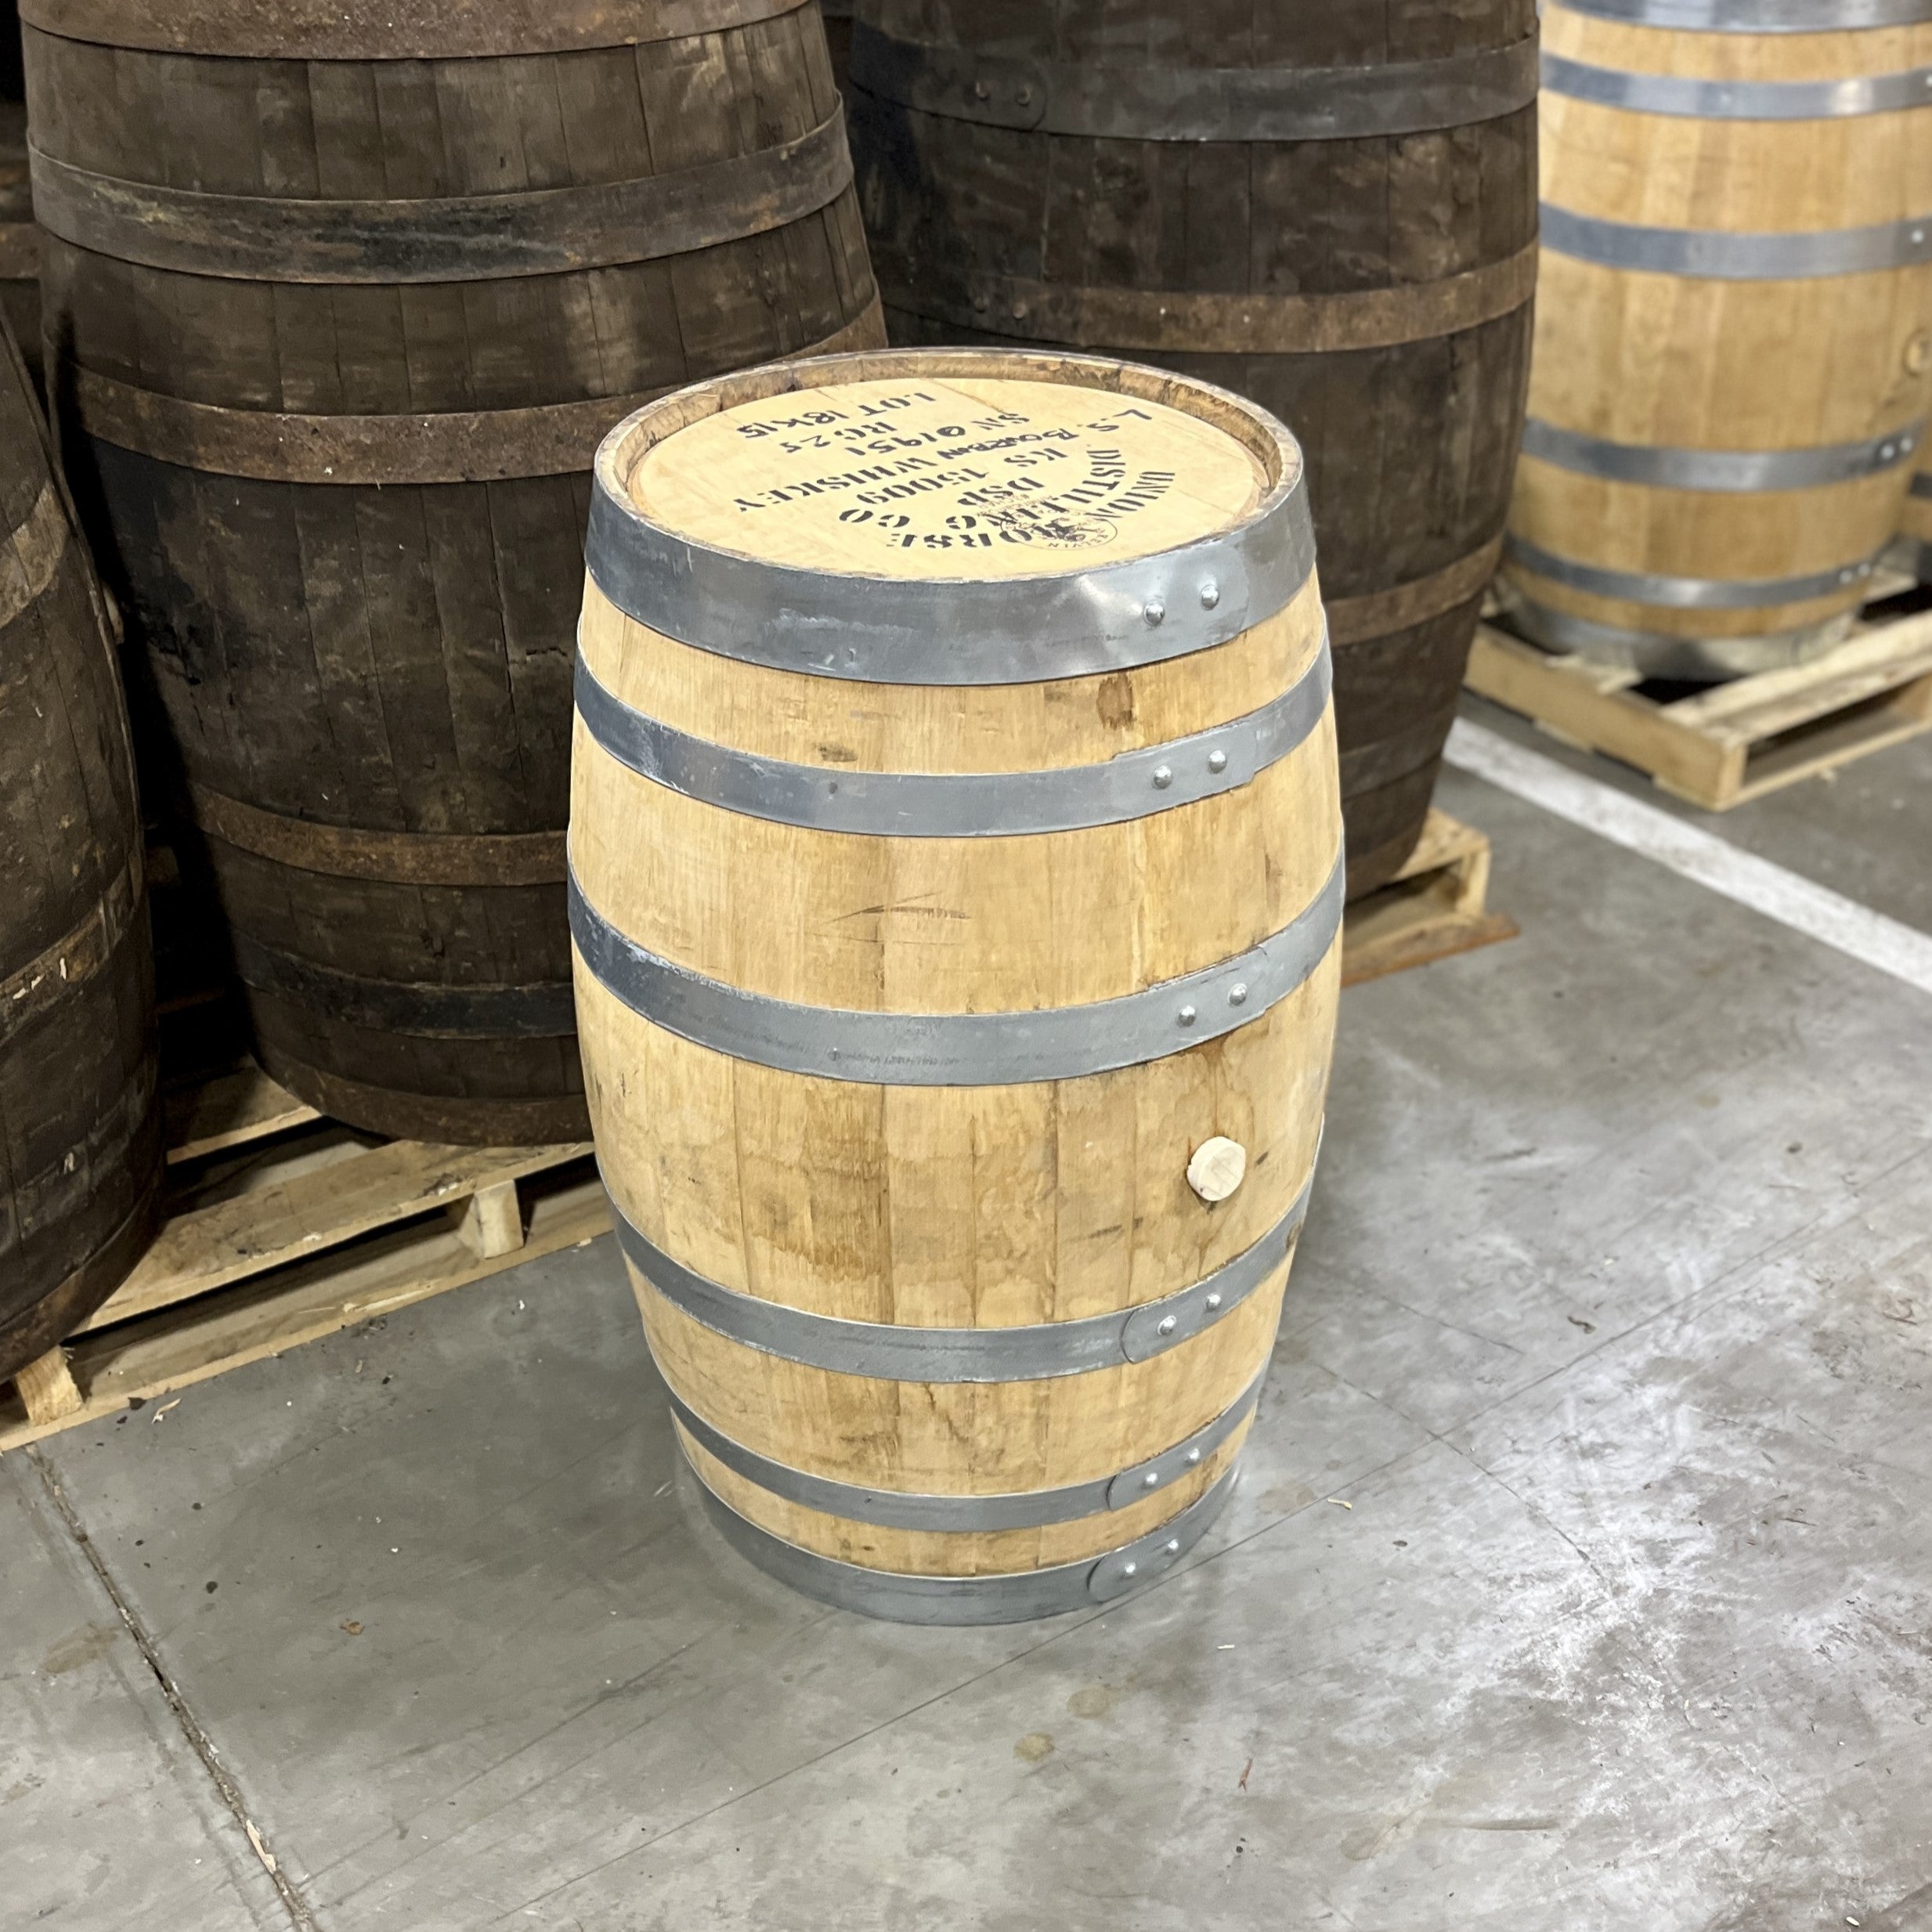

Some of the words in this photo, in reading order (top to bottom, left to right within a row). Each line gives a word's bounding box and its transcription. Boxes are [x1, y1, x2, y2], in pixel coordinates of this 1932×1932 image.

[858, 392, 936, 416] LOT
[834, 422, 897, 441] RG
[971, 413, 1030, 431] SN
[1004, 448, 1068, 468] KS
[733, 457, 938, 512] WHISKEY
[856, 468, 989, 504] 15009
[957, 477, 1045, 506] DSP
[1084, 471, 1175, 518] UNION
[839, 509, 910, 529] CO
